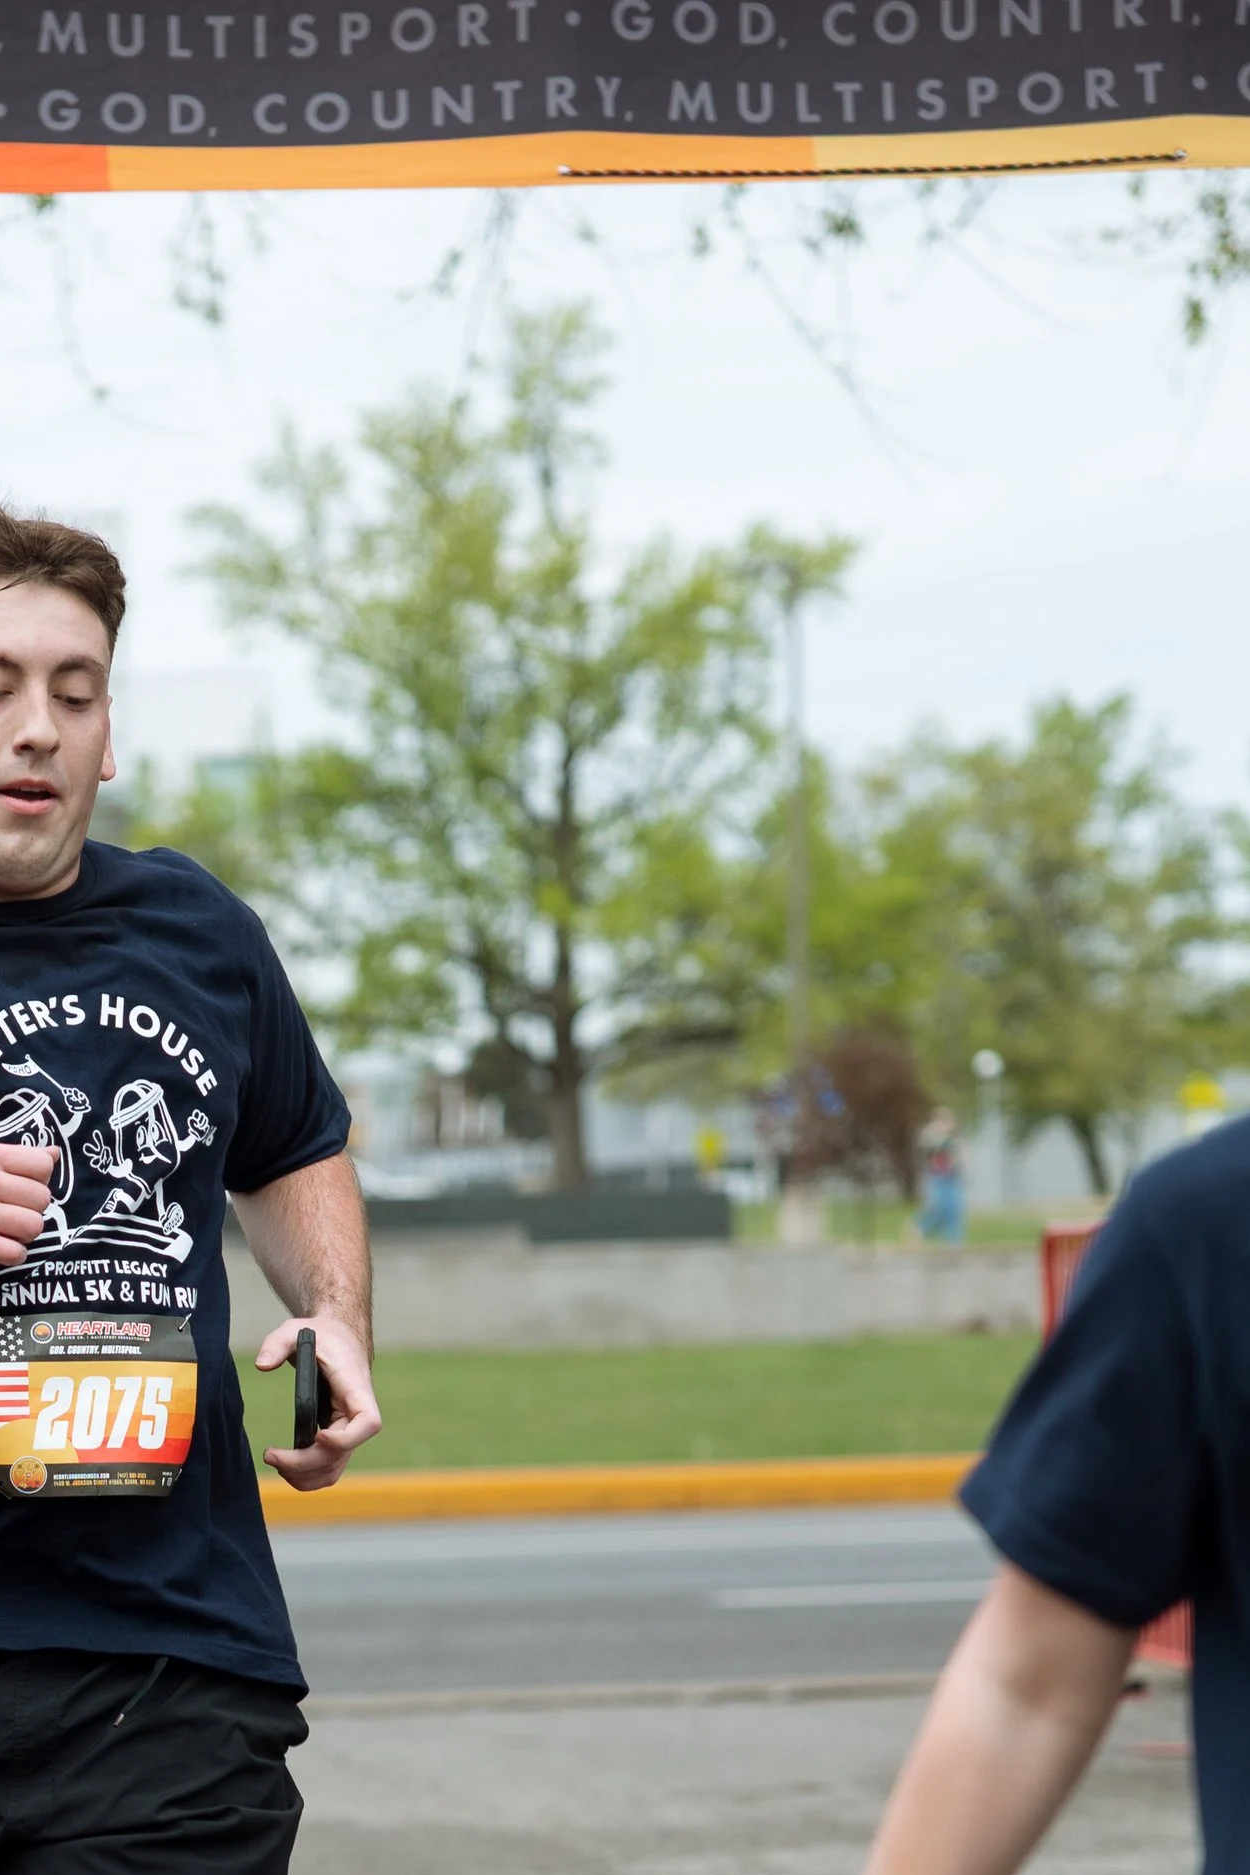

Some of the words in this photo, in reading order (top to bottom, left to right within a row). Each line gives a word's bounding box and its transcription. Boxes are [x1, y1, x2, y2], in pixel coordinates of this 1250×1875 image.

[37, 0, 536, 59] MULTISPORT
[611, 0, 788, 50] GOD,
[38, 90, 218, 138] GOD,
[253, 76, 634, 134] COUNTRY,
[668, 62, 1163, 125] MULTISPORT
[100, 993, 218, 1097] HOUSE
[44, 1259, 110, 1276] PROFFITT
[114, 1259, 168, 1278] LEGACY
[84, 1279, 115, 1301] 5K
[120, 1280, 135, 1302] &
[140, 1281, 171, 1307] FUN
[174, 1286, 198, 1309] RU
[57, 1321, 152, 1338] HEARTLAND
[32, 1375, 174, 1450] 2075
